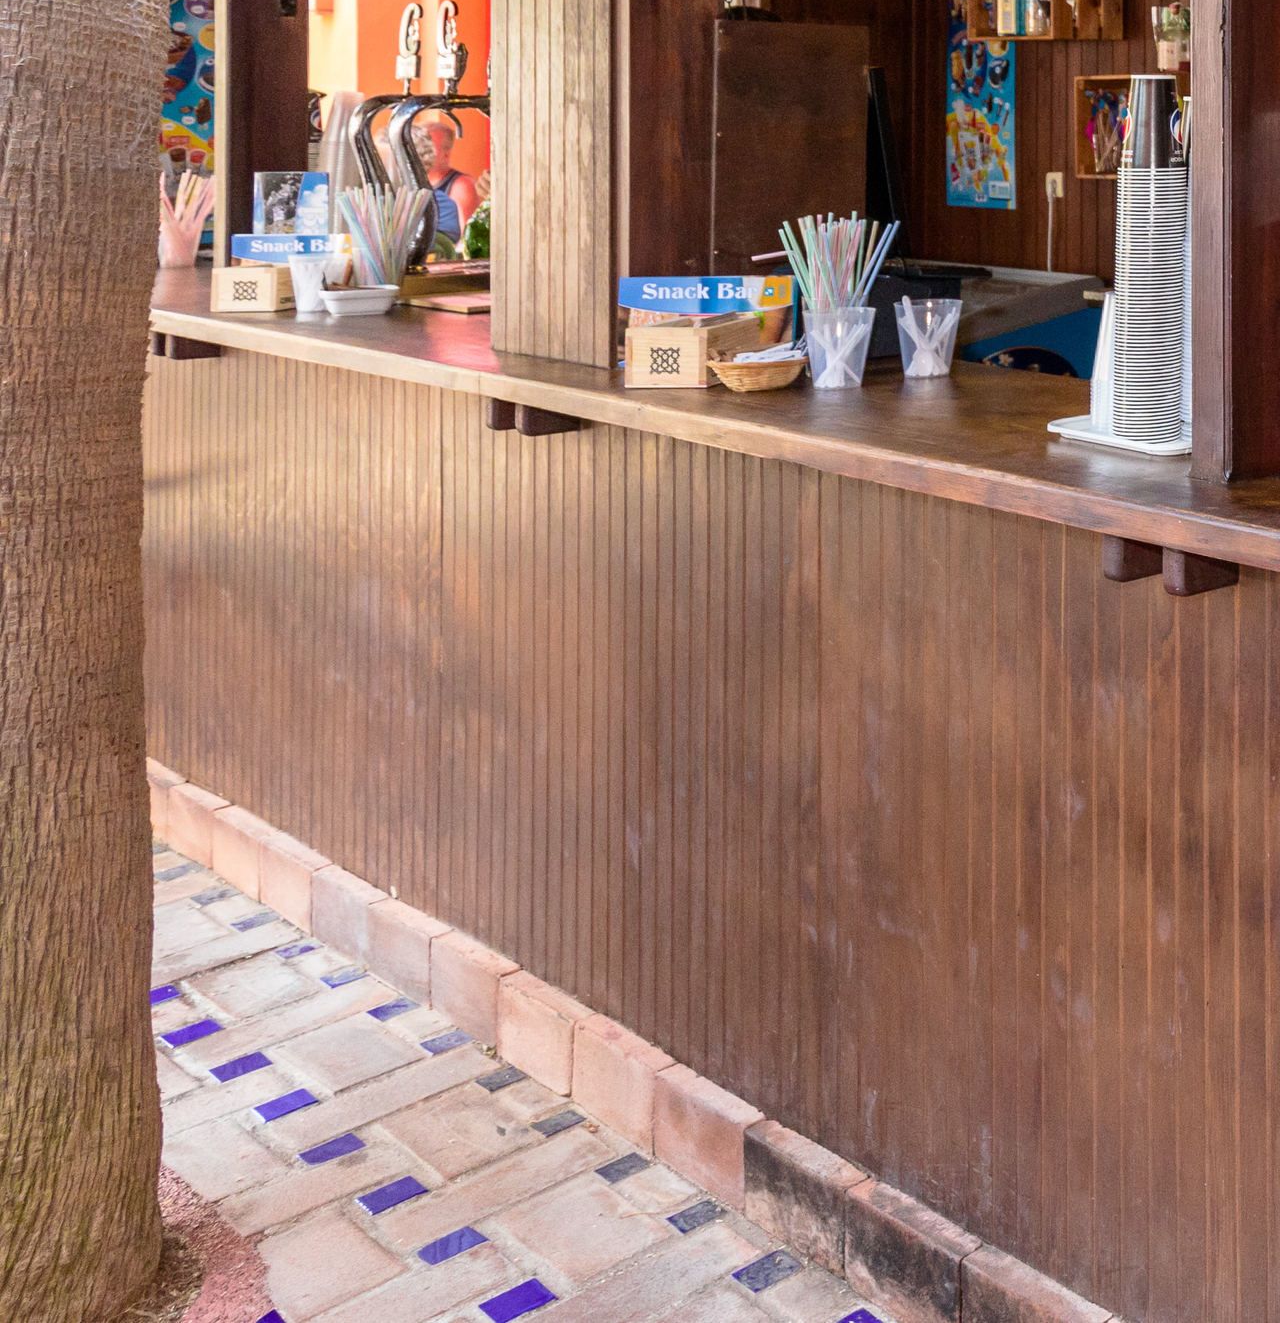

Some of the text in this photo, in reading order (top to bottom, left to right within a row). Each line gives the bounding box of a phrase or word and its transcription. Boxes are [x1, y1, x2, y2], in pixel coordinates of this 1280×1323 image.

[250, 239, 304, 253] Snack
[642, 283, 758, 300] Snack Bar
